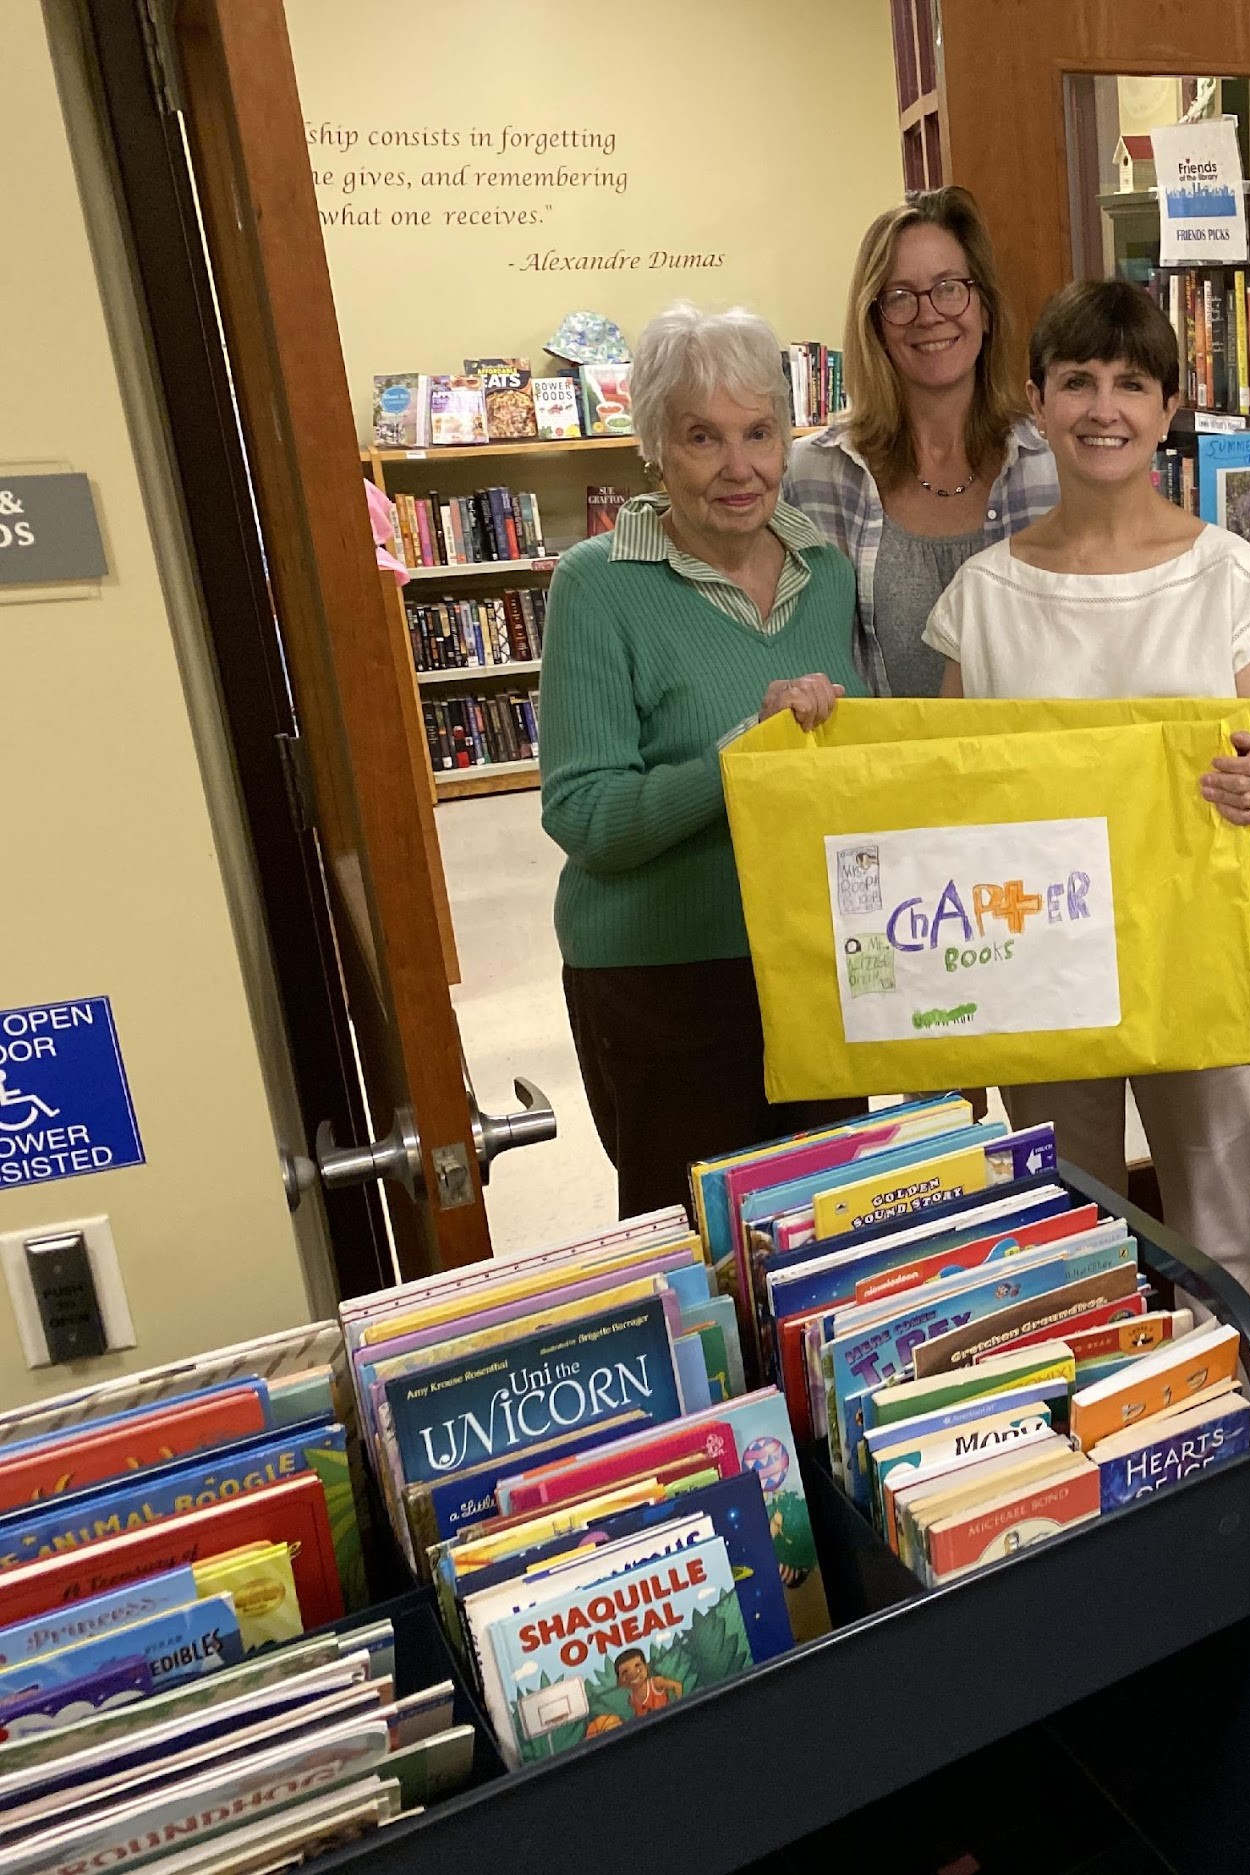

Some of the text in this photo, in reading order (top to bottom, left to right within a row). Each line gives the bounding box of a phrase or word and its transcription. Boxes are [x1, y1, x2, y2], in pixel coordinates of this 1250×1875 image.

[305, 121, 617, 155] ship consists in forgetting
[342, 166, 412, 194] gives,
[421, 164, 471, 187] and
[474, 165, 628, 194] remembering
[1178, 161, 1217, 175] Friends
[319, 203, 382, 226] what
[391, 211, 432, 226] one
[1177, 228, 1230, 241] FRIENDS PICKS
[648, 250, 726, 270] Dumas
[534, 380, 571, 391] POWER
[535, 390, 573, 402] FOODS
[0, 490, 24, 515] &
[588, 494, 626, 504] GRAFTON
[599, 486, 615, 495] SUE
[3, 1004, 93, 1036] OPEN
[0, 1147, 112, 1182] SISTED
[851, 1186, 964, 1229] SOUND STORY
[872, 1177, 940, 1208] GOLDEN
[864, 1271, 919, 1298] nickelodeon
[578, 1326, 611, 1344] Brigette
[611, 1313, 649, 1334] Barrager
[844, 1310, 938, 1364] HERE COMES
[950, 1321, 1020, 1363] Gretchen
[406, 1359, 509, 1401] Amy Krouse Rosenthal
[508, 1360, 581, 1396] Uni the
[1127, 1428, 1225, 1487] HEARTS
[38, 1503, 163, 1557] ANIMAL
[174, 1452, 296, 1513] BOOGIE
[450, 1511, 460, 1523] a
[967, 1487, 1070, 1537] MICHAEL BOND
[64, 1545, 198, 1600] A Treasury of
[519, 1558, 708, 1653] SHAQUILLE
[27, 1596, 157, 1651] Princess
[560, 1602, 684, 1667] O'NEAL
[152, 1627, 222, 1677] EDIBLES
[56, 1761, 342, 1875] ROUNDHOG
